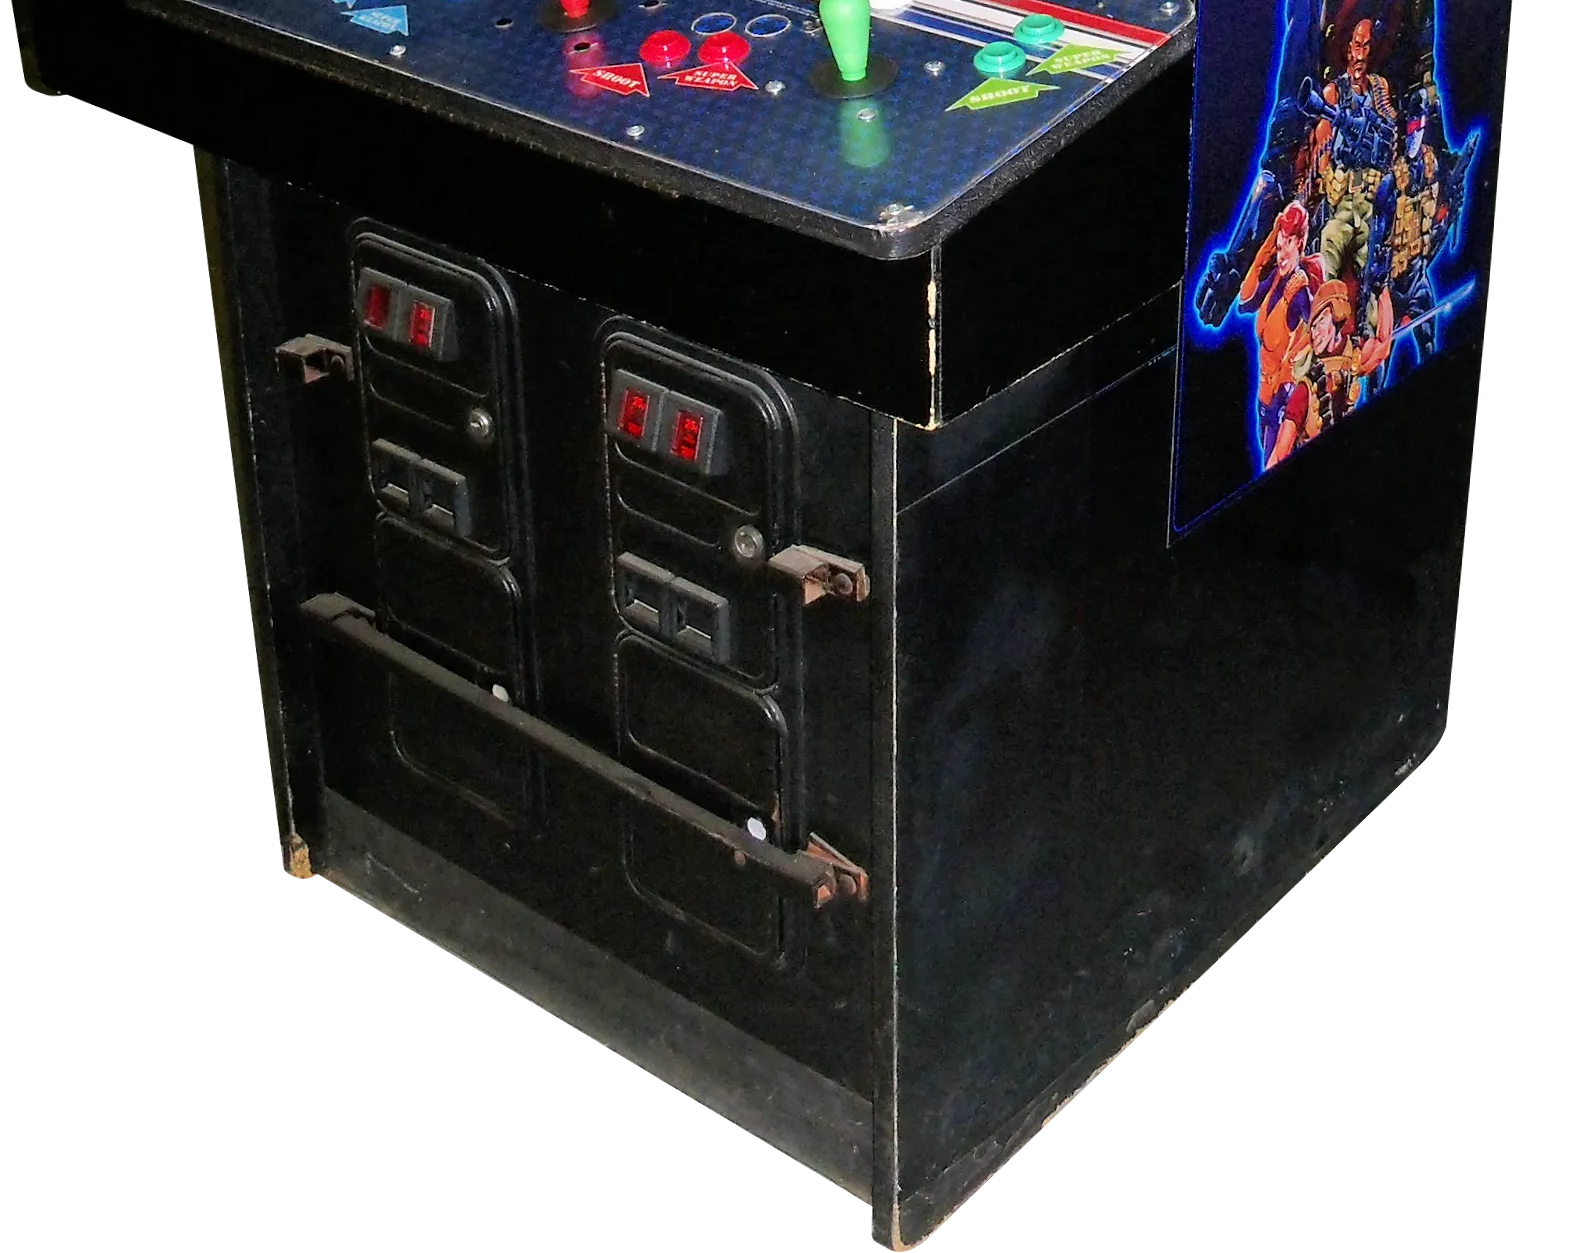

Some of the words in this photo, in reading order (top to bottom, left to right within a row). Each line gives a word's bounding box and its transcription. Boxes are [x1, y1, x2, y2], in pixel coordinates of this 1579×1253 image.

[592, 69, 642, 89] SHOOT
[684, 75, 738, 87] WEAPON
[692, 70, 738, 81] SUPER
[969, 84, 1031, 104] SHOOT
